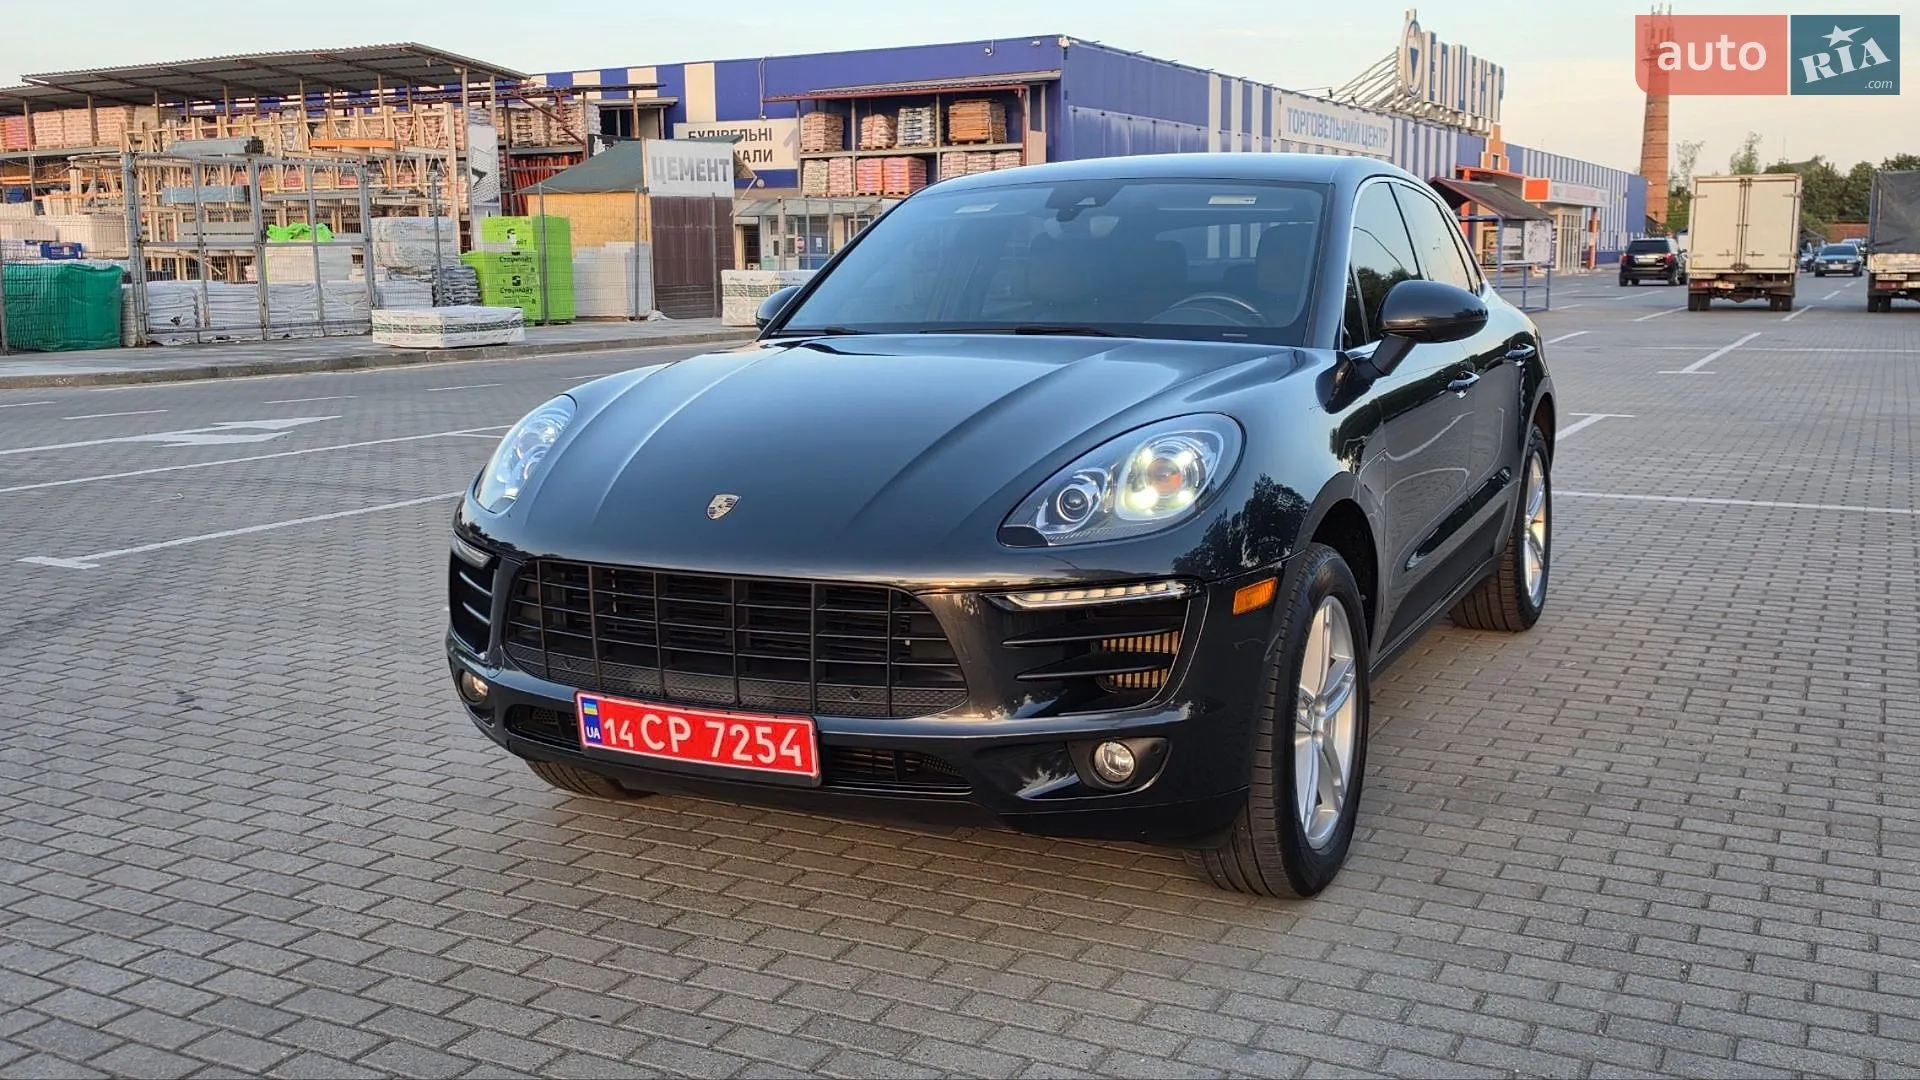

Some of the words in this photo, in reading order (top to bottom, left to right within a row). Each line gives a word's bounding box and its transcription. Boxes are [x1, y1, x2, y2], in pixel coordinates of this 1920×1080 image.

[1361, 124, 1388, 149] ЦЕНТР
[652, 156, 730, 184] ЦЕМЕНТ
[586, 726, 601, 740] UA
[704, 720, 803, 767] 7254
